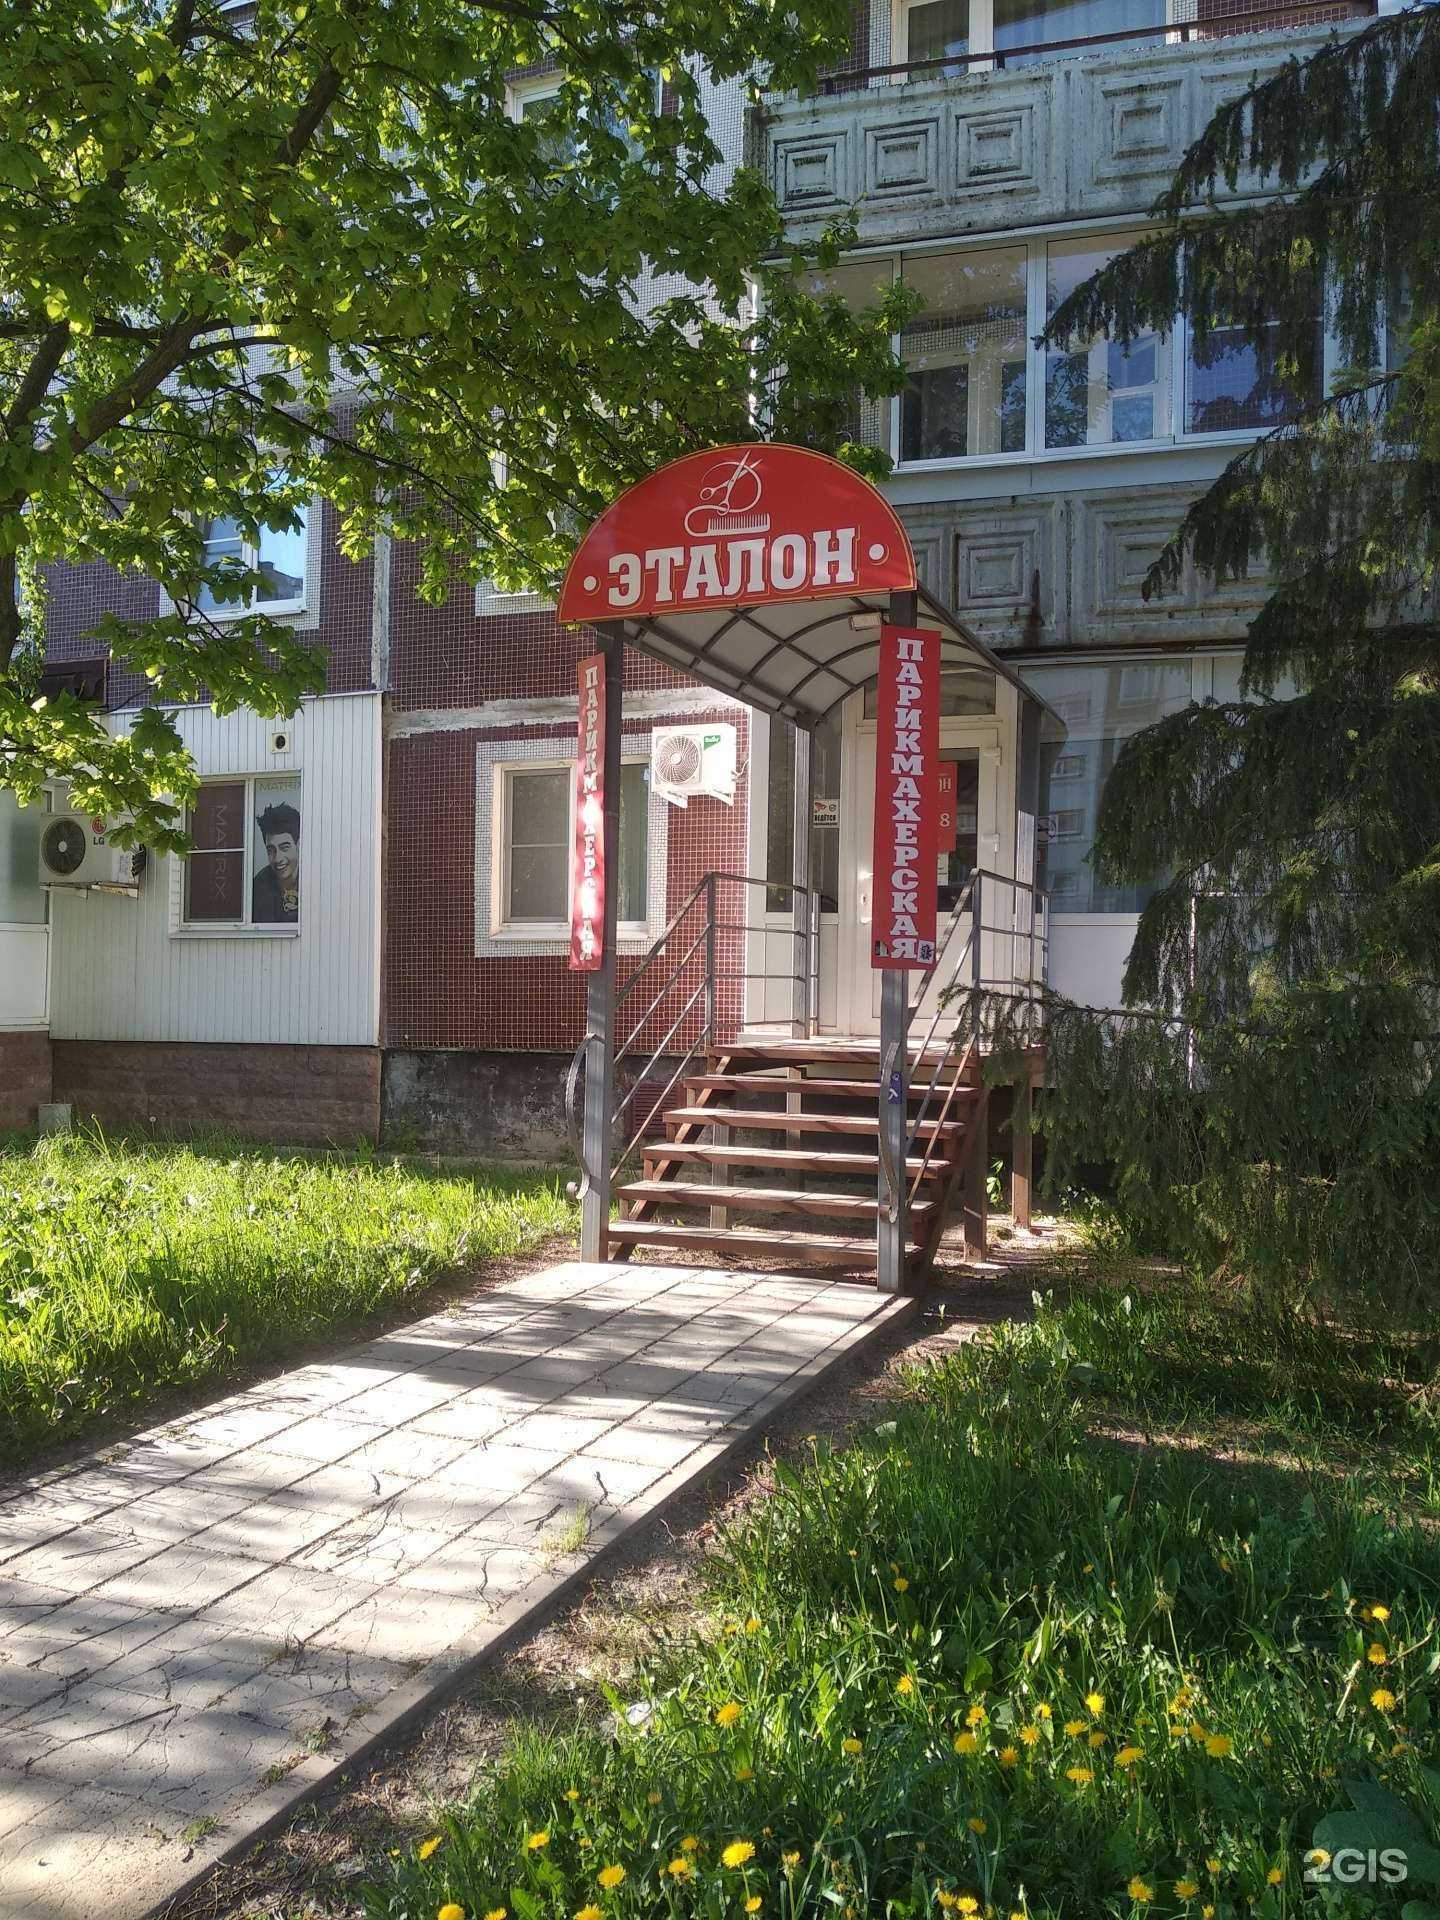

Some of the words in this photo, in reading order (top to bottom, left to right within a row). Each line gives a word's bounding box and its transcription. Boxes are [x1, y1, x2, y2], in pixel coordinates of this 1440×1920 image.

[608, 527, 857, 607] ЭТАЛОН
[93, 836, 105, 846] LG
[890, 638, 925, 959] ПАРИКМАХЕРСКАЯ
[215, 804, 228, 899] MARIX
